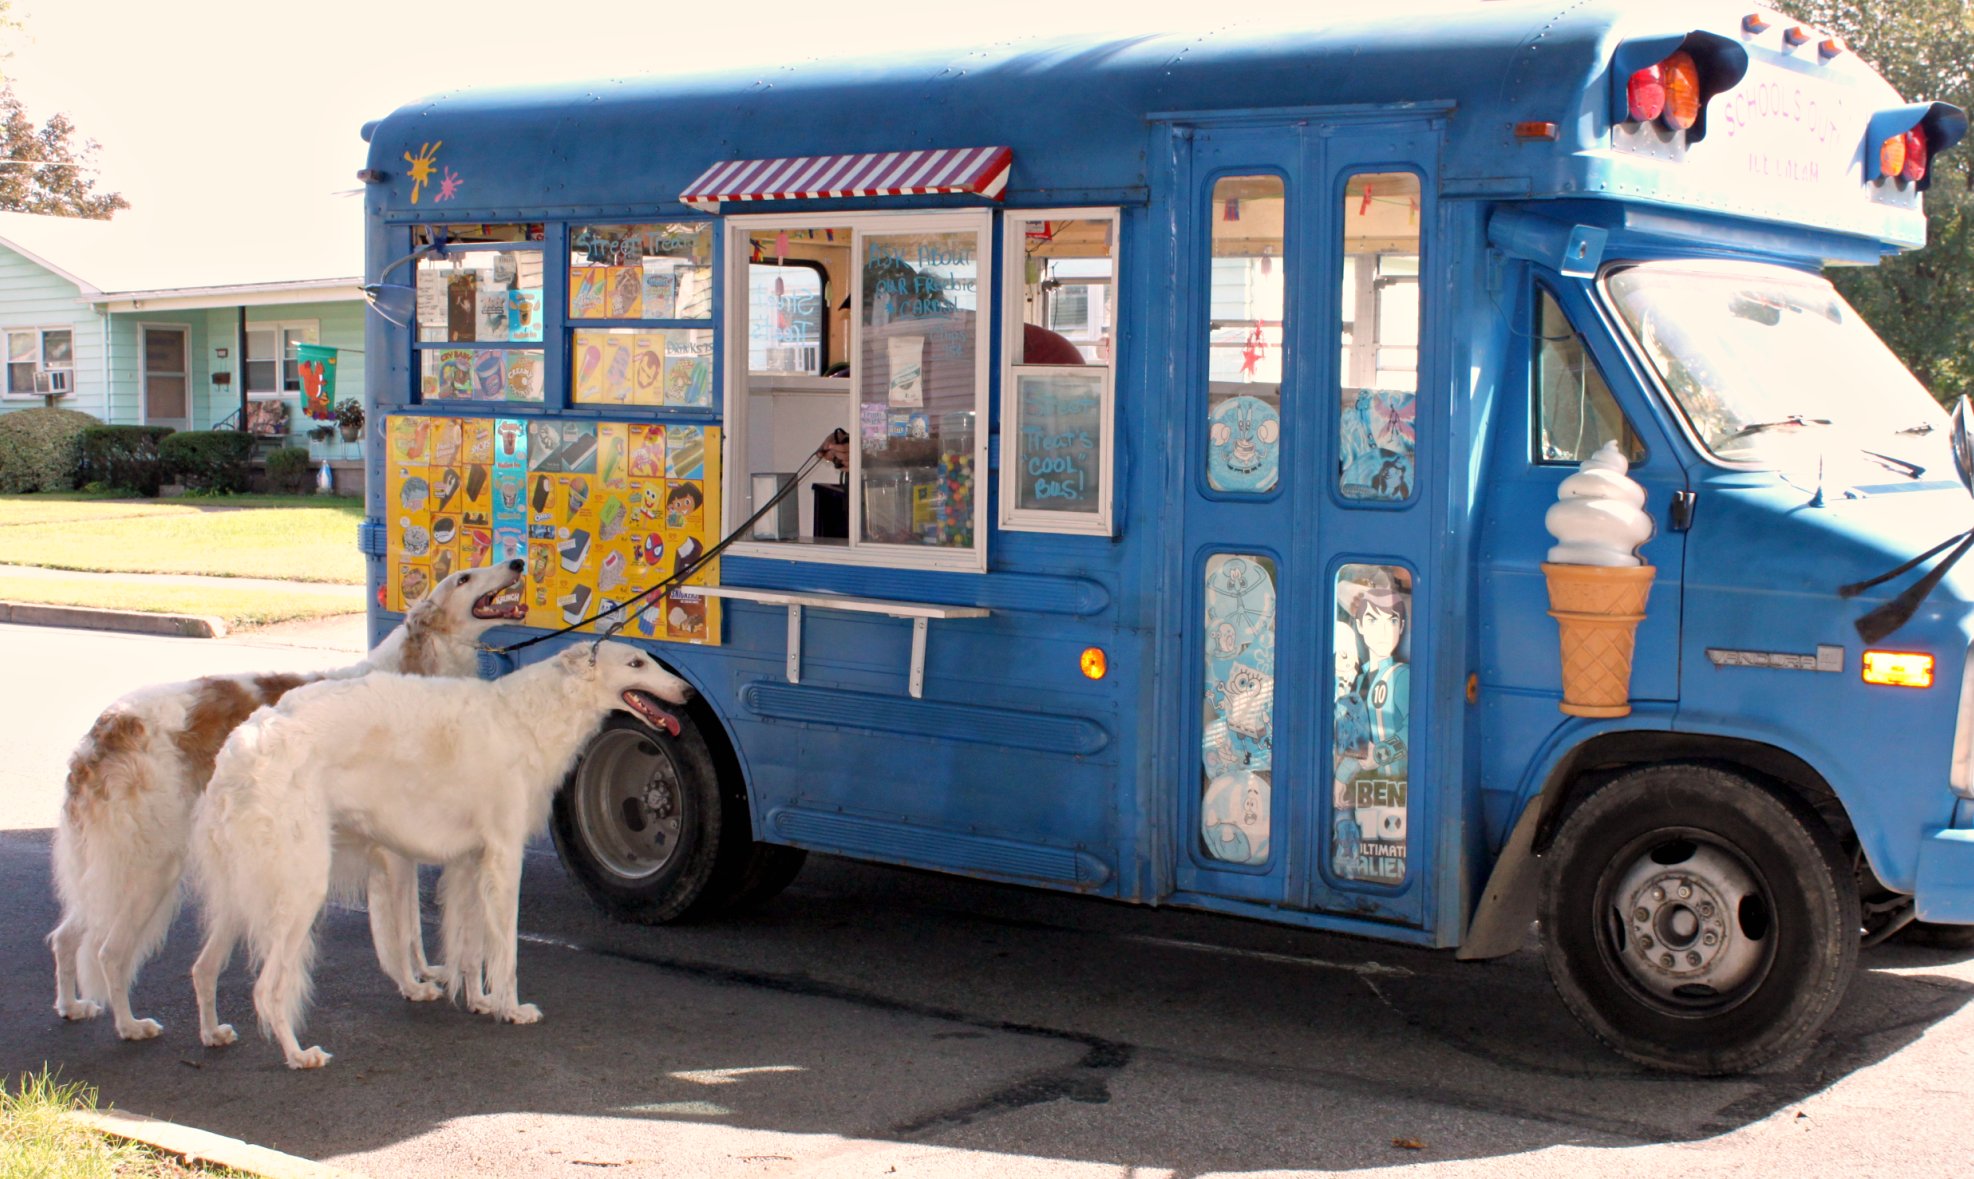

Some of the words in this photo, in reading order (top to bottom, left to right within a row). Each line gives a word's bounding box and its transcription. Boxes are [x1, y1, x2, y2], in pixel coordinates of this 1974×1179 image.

[1374, 684, 1387, 704] 10
[1355, 779, 1407, 809] BEN
[1355, 806, 1407, 841] 10
